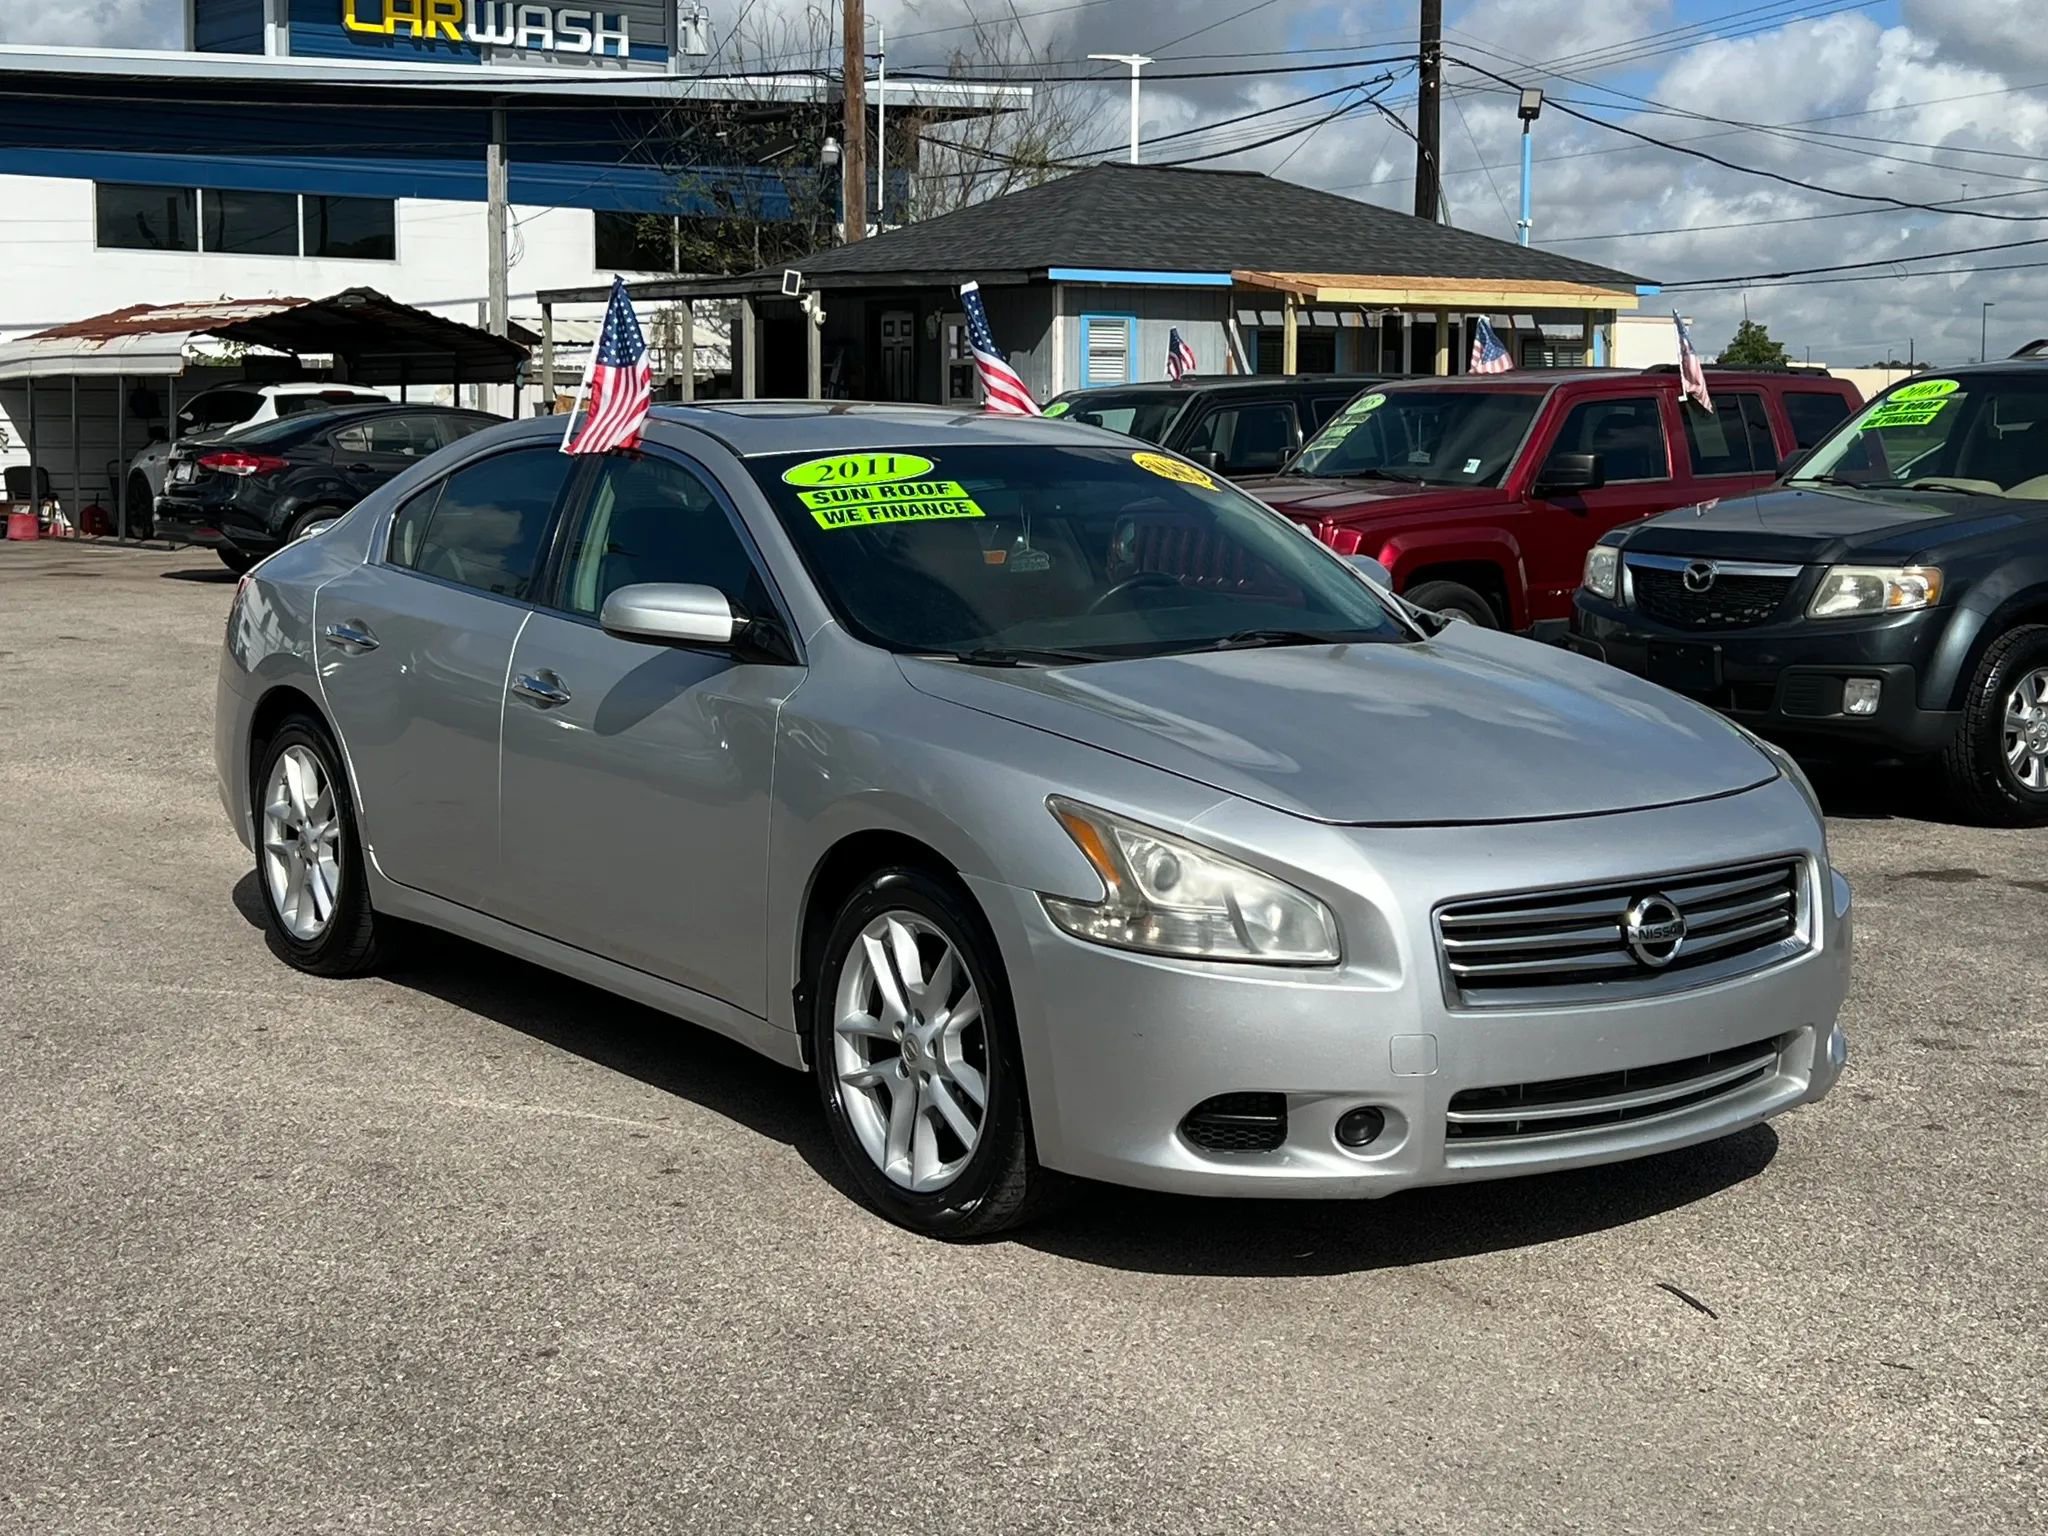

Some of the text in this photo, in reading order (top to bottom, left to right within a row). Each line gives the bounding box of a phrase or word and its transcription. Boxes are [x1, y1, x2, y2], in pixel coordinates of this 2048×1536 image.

[1902, 401, 1941, 412] ROOF
[1881, 414, 1930, 425] FINANCE
[816, 457, 895, 482] 2011
[812, 483, 949, 505] SUN ROOF
[823, 500, 970, 525] WE FINANCE
